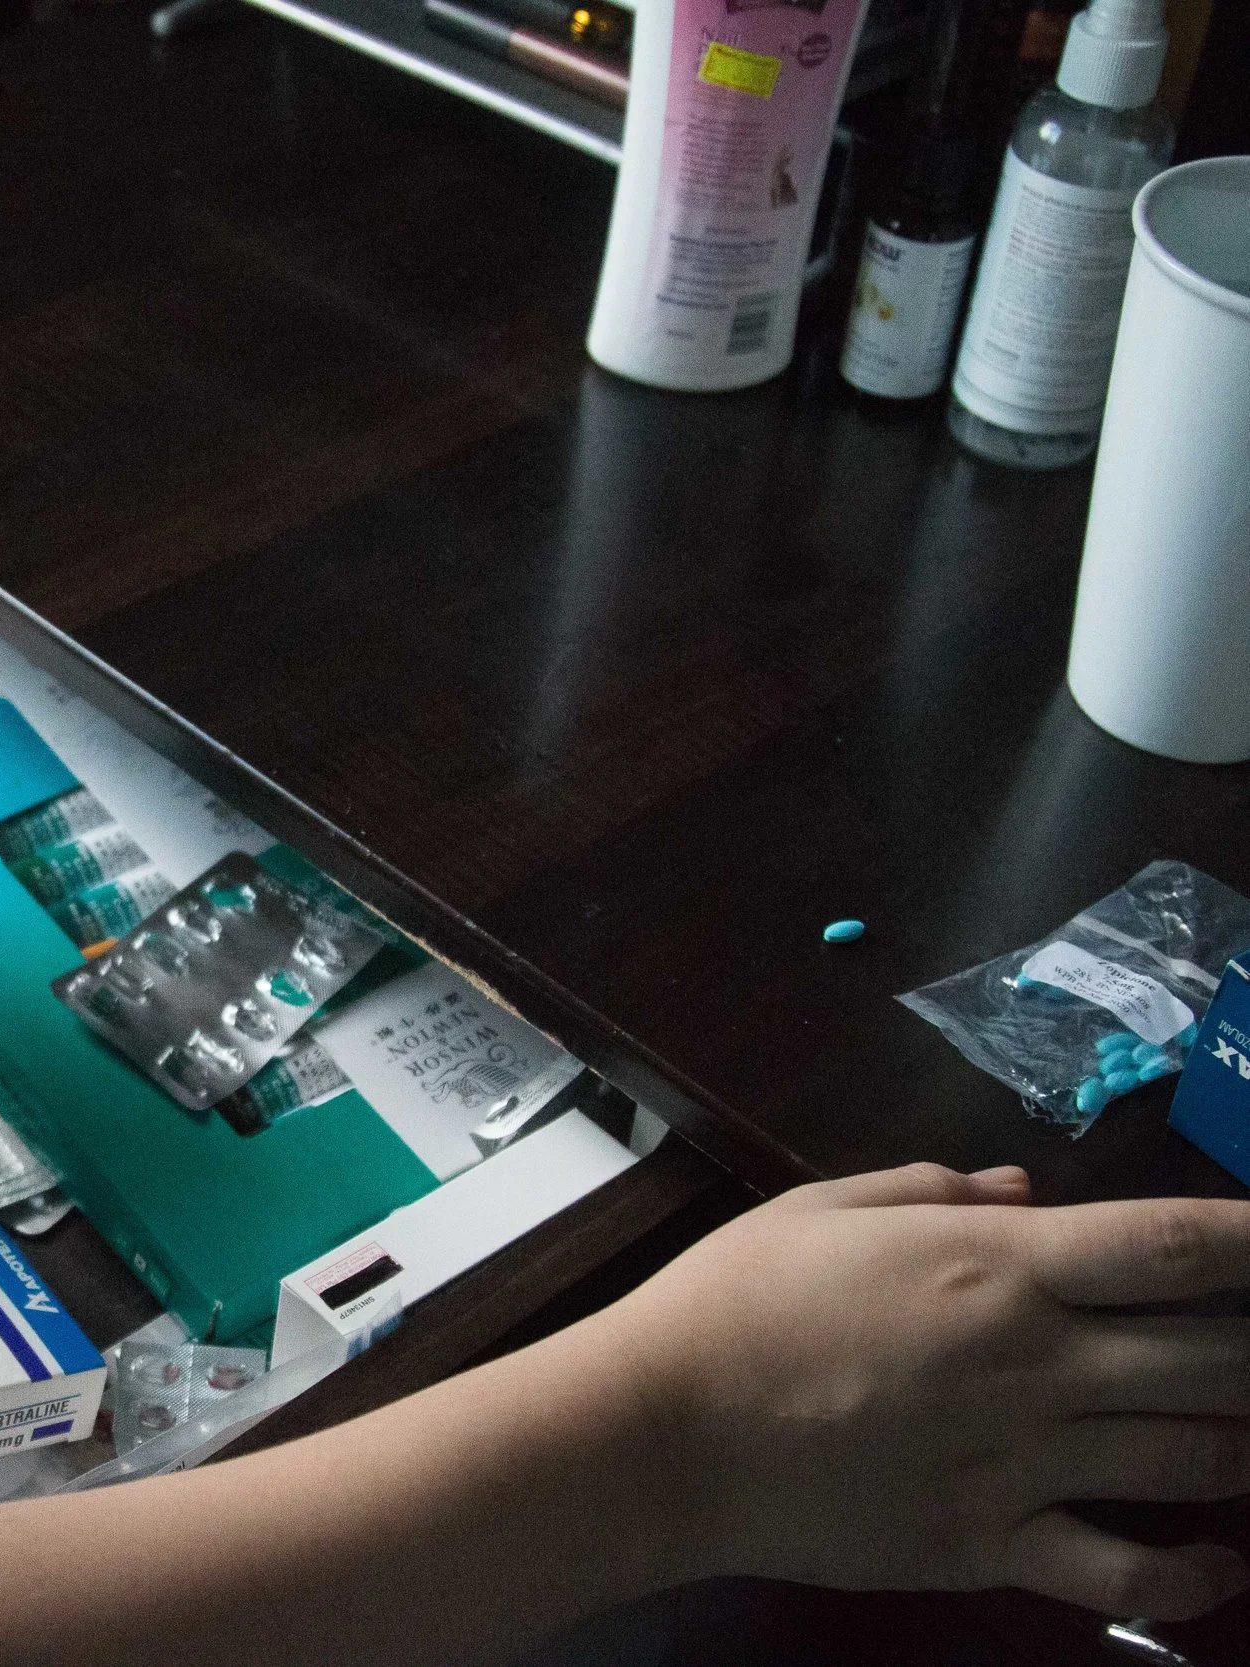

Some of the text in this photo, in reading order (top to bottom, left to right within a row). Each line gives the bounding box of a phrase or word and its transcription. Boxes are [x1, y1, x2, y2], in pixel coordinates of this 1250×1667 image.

[387, 1009, 480, 1055] NEWTON
[405, 1026, 499, 1077] WINSOR
[1218, 1020, 1250, 1049] ZOLAM
